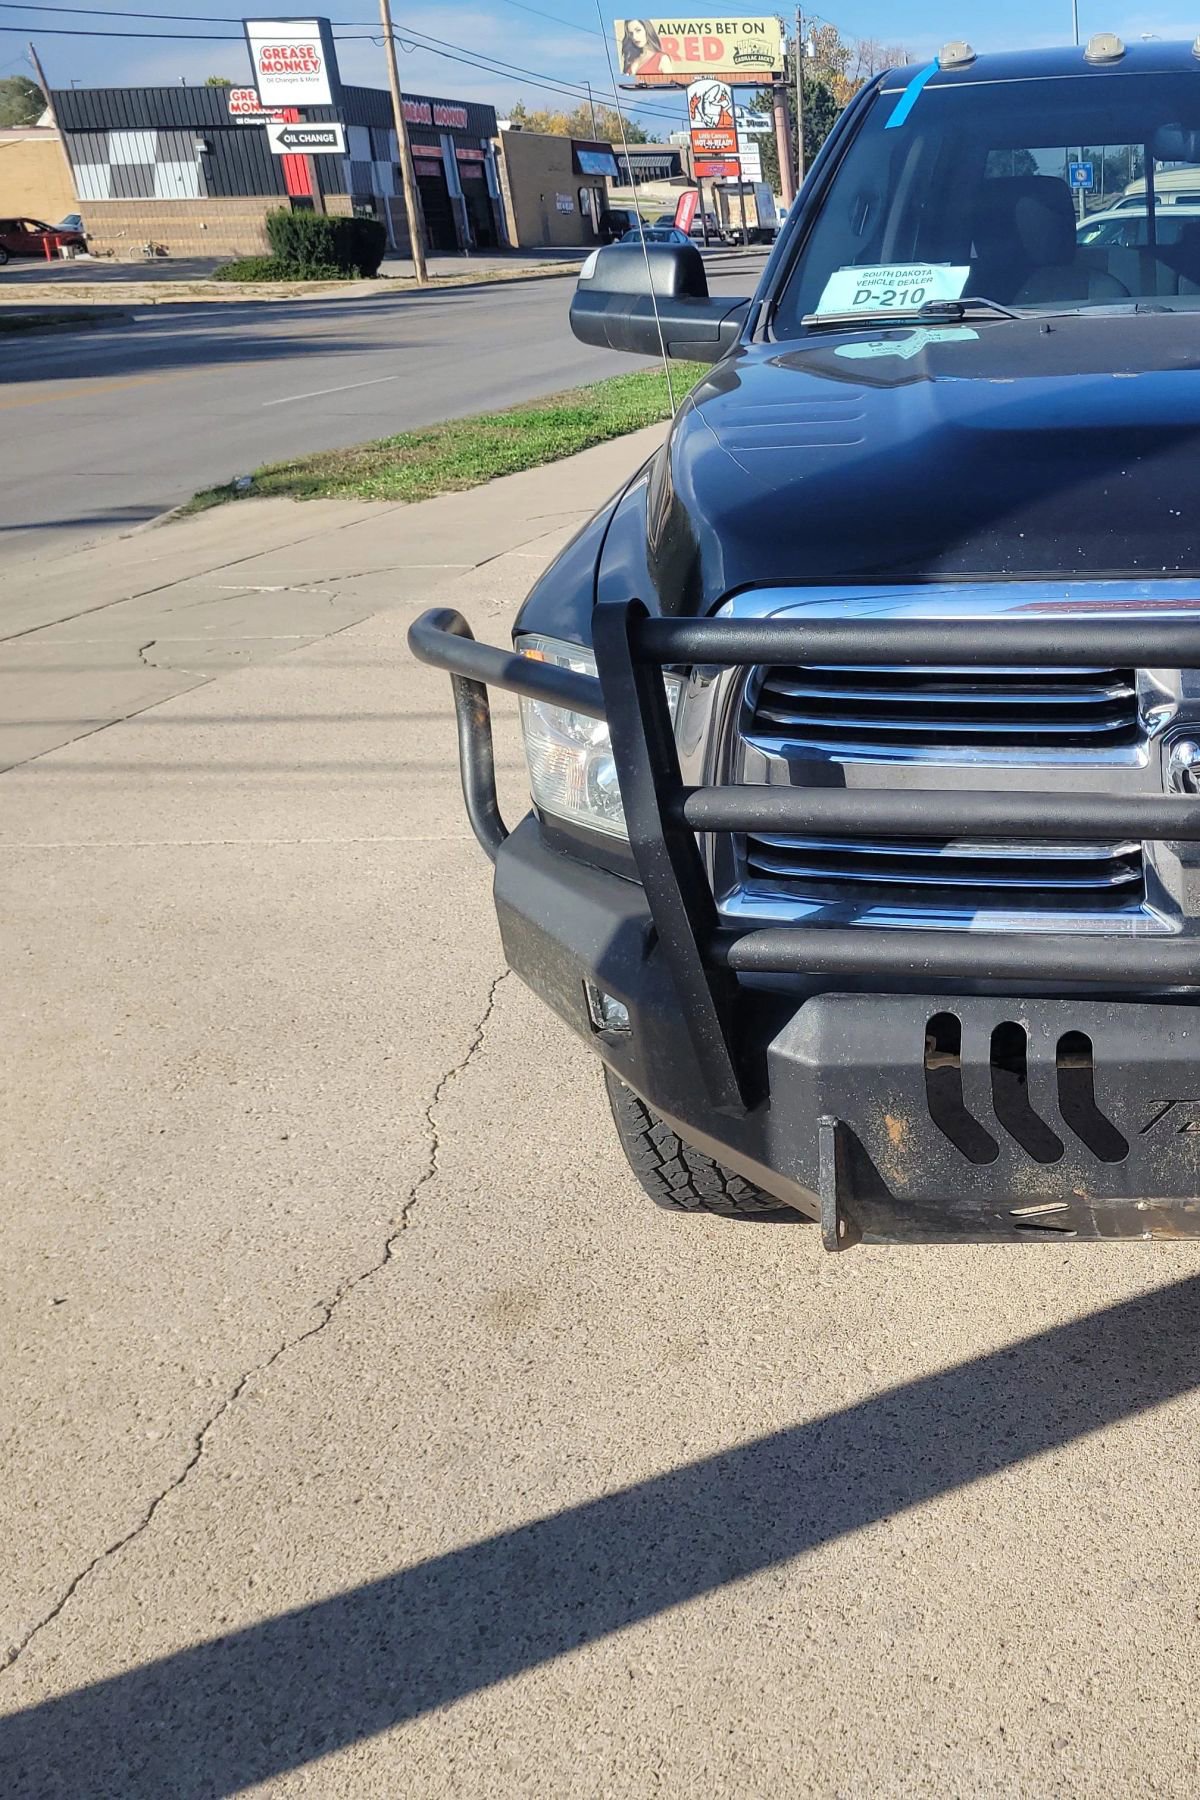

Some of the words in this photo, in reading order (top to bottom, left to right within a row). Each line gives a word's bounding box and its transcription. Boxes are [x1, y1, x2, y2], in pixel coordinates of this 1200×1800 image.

[657, 22, 712, 35] ALWAYS
[716, 22, 738, 34] BET
[742, 22, 765, 34] ON
[262, 46, 315, 60] GREASE
[660, 36, 724, 62] RED
[261, 59, 320, 73] MONKEY
[231, 90, 255, 102] GRE
[283, 134, 298, 143] OIL
[298, 134, 335, 142] CHANGE
[895, 269, 932, 278] DAKOTA
[856, 278, 895, 287] VEHICLE
[897, 277, 933, 287] DEALER
[852, 287, 926, 306] D-210
